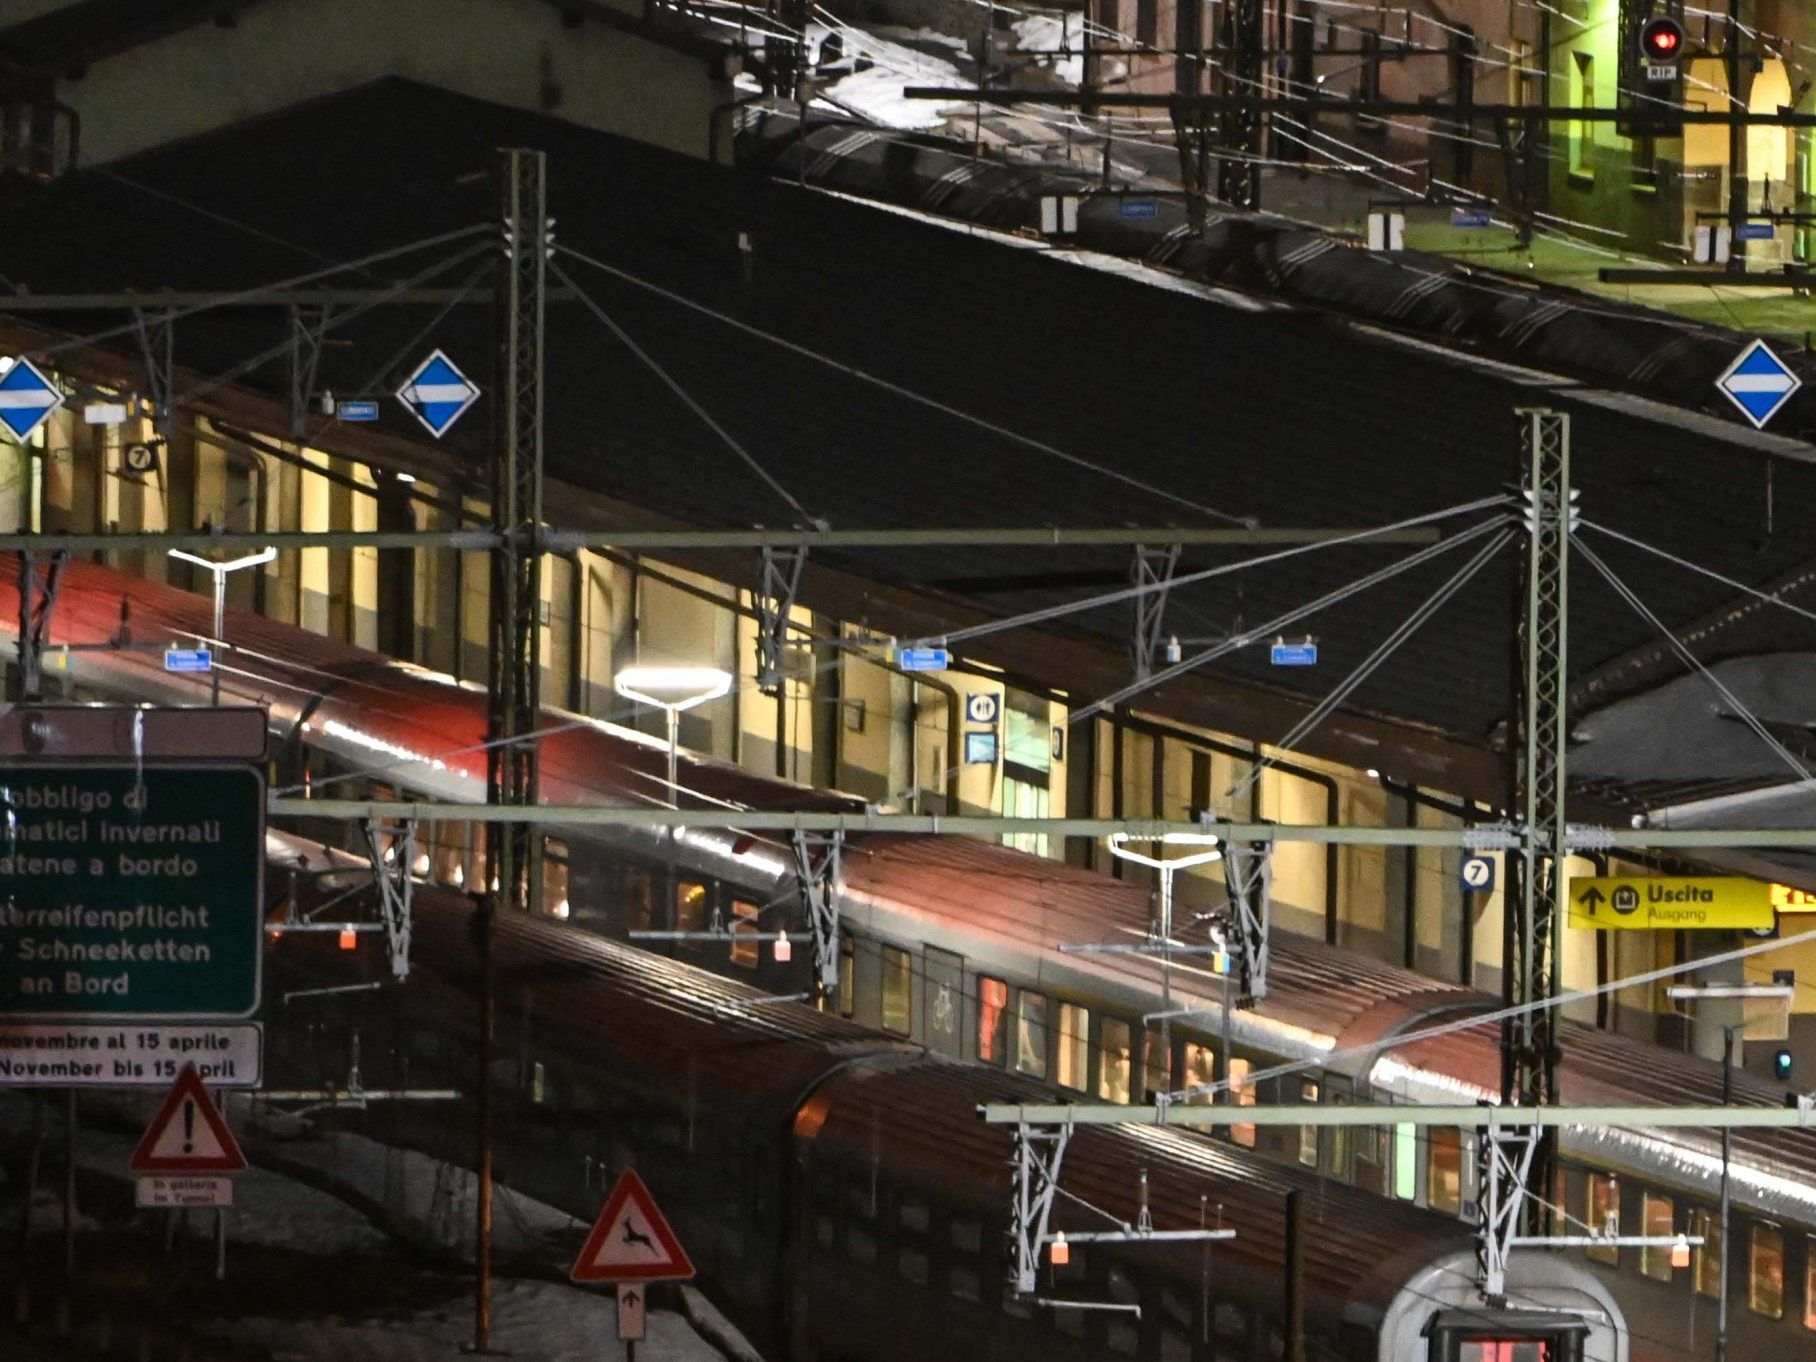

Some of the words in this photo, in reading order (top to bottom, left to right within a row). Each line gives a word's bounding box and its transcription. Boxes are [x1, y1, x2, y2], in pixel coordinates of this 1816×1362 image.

[133, 450, 146, 466] 7
[101, 819, 220, 843] invernali
[89, 858, 104, 876] a
[118, 852, 198, 877] bordo
[1471, 865, 1482, 880] 7
[1647, 884, 1714, 903] Uscita
[1647, 902, 1708, 922] Ausgang
[17, 937, 212, 963] Schneeketten
[19, 976, 53, 994] an
[64, 970, 129, 995] Bord
[107, 1034, 126, 1049] al
[137, 1033, 160, 1049] 15
[169, 1034, 230, 1052] aprile
[113, 1060, 143, 1077] bis
[154, 1060, 176, 1076] 15
[184, 1060, 236, 1081] pril
